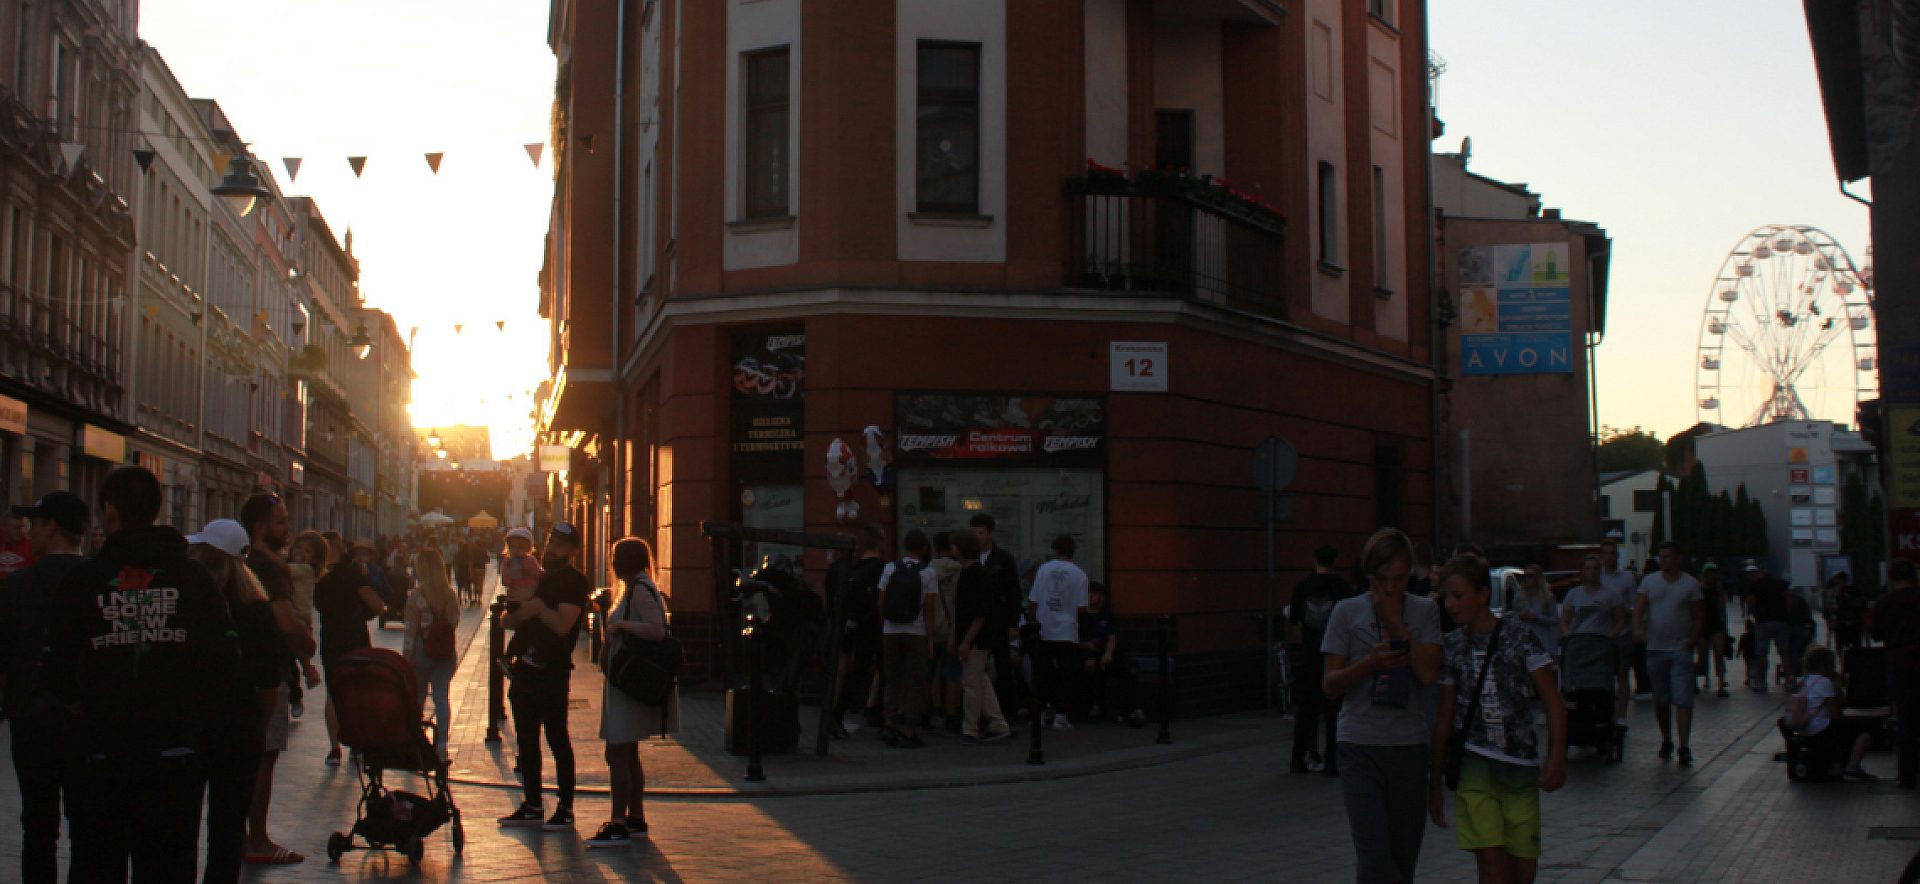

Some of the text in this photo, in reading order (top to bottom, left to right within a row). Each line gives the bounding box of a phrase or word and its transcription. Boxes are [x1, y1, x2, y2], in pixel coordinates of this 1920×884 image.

[1467, 347, 1568, 368] AVON
[1124, 358, 1153, 377] 12
[899, 434, 957, 451] TEMPISH
[969, 431, 1032, 442] Centrum
[1043, 436, 1101, 452] TEMPISH
[97, 593, 103, 608] I
[102, 602, 177, 621] SOME
[89, 629, 186, 650] FRIENDS
